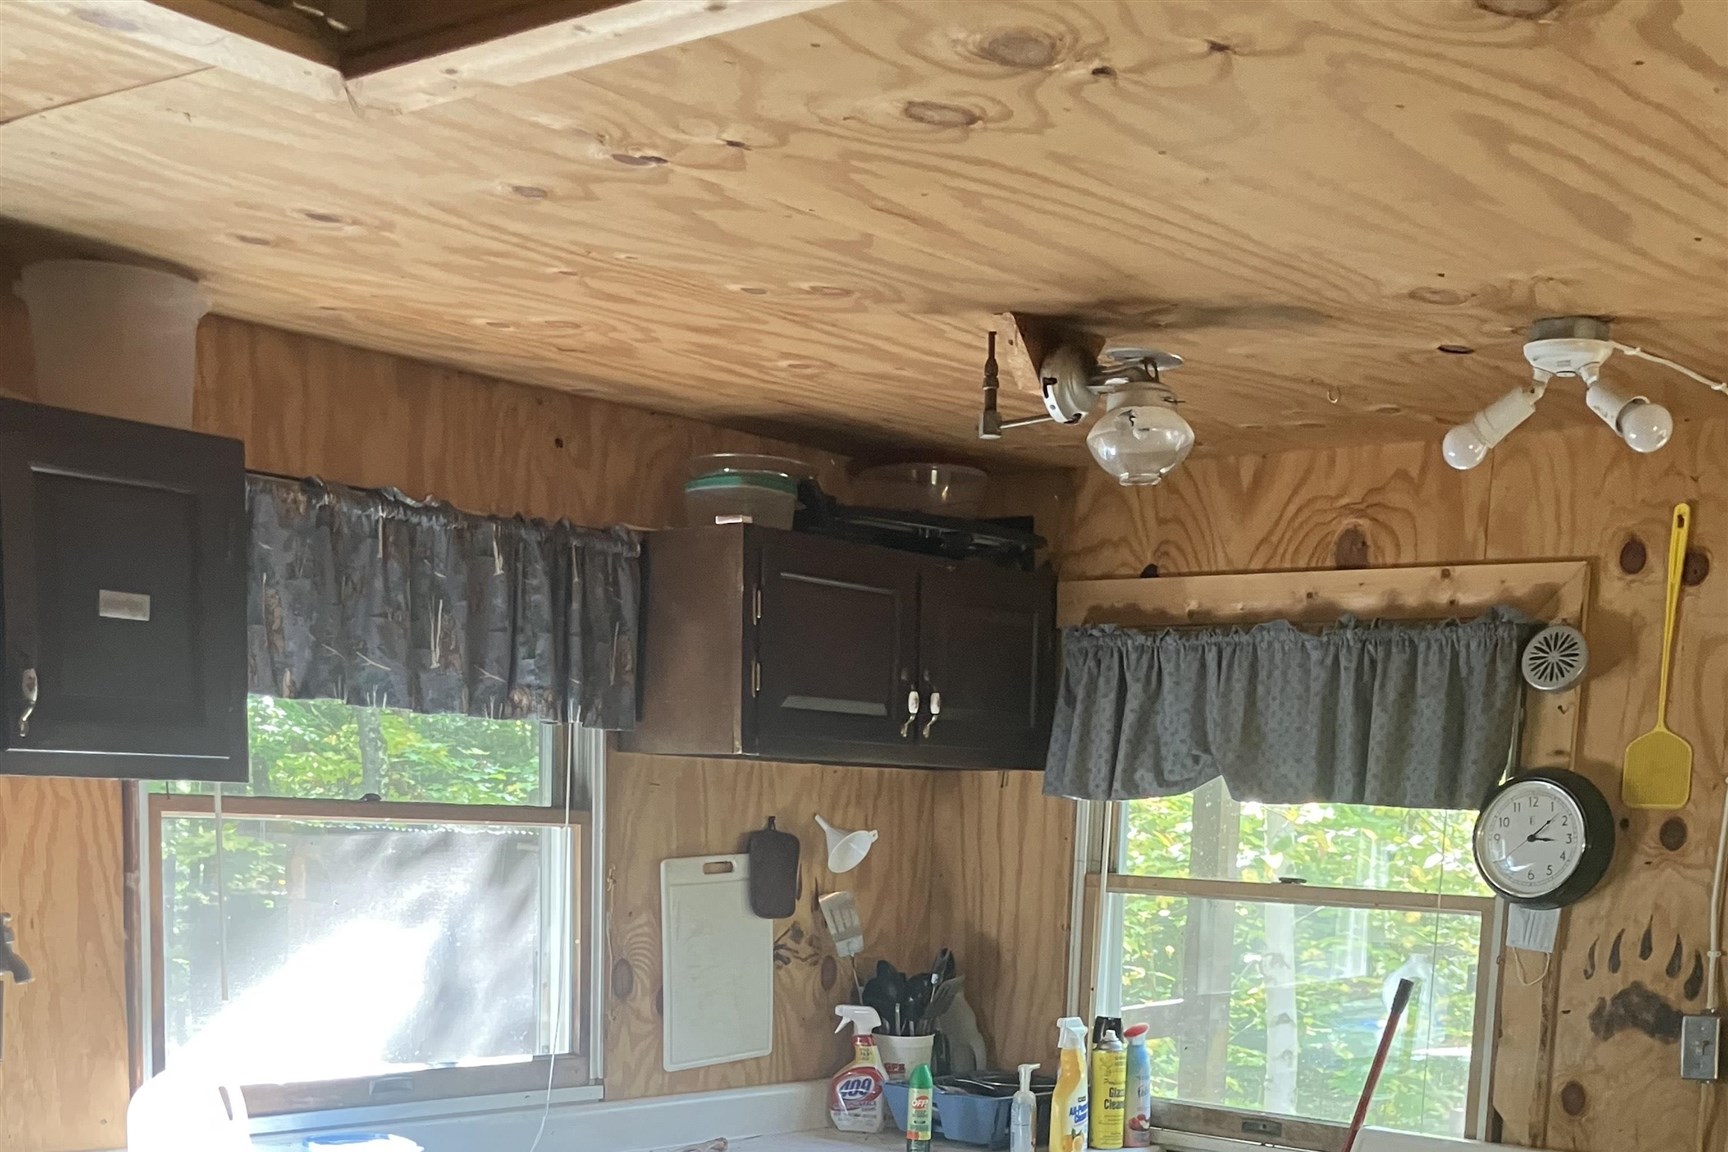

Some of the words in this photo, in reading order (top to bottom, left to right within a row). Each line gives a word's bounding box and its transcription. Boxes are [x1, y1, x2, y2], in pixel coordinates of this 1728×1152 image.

[1513, 802, 1521, 813] 11
[1528, 796, 1539, 808] 12
[1499, 816, 1510, 828] 10
[1561, 815, 1568, 827] 2
[1493, 833, 1501, 845] 9
[1565, 833, 1573, 845] 3
[1559, 850, 1566, 861] 4
[1527, 869, 1535, 881] 6
[1545, 864, 1553, 876] 5
[839, 1078, 873, 1098] 409
